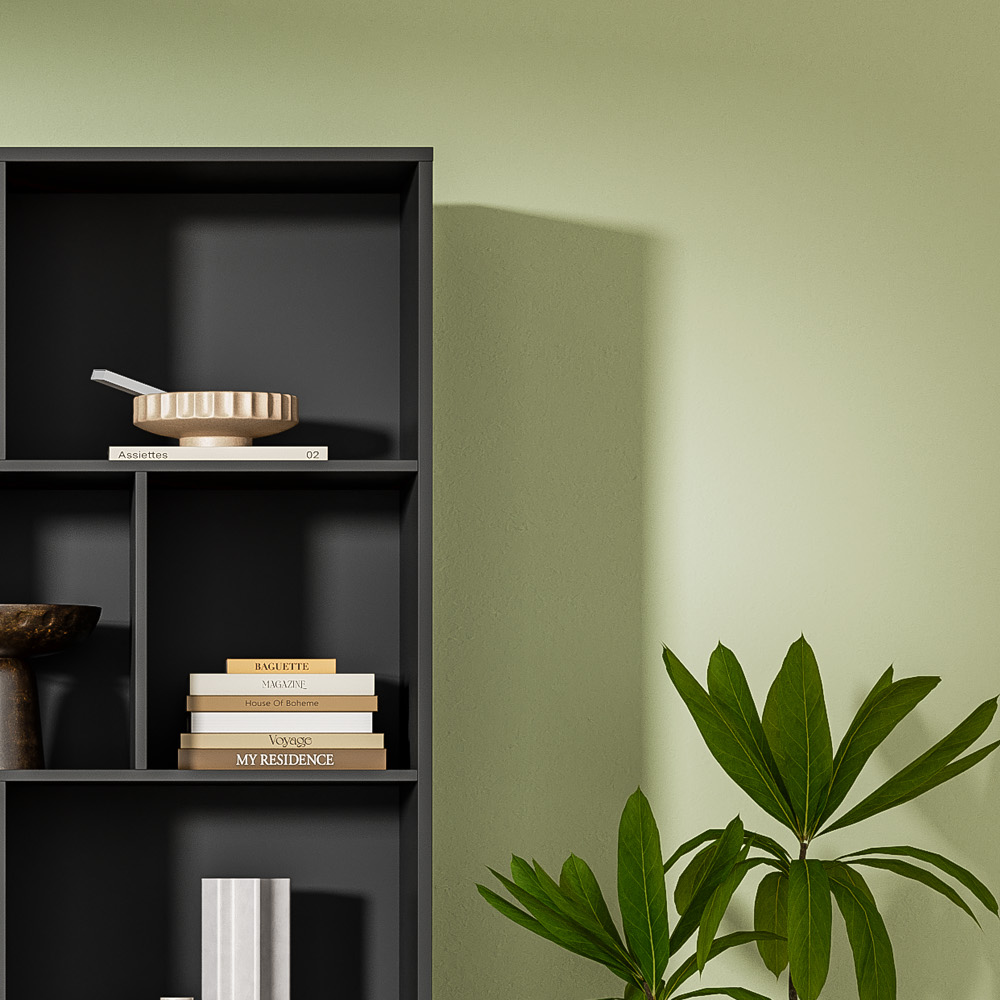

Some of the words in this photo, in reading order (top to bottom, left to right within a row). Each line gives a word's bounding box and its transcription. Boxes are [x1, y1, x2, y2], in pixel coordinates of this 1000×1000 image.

[118, 451, 168, 459] Assiettes
[306, 451, 319, 459] 02
[255, 662, 309, 671] BAGUETTE
[262, 680, 307, 689] MAGAZINE
[269, 734, 312, 747] Voyage
[236, 754, 258, 766] MY
[260, 754, 334, 766] RESIDENCE
